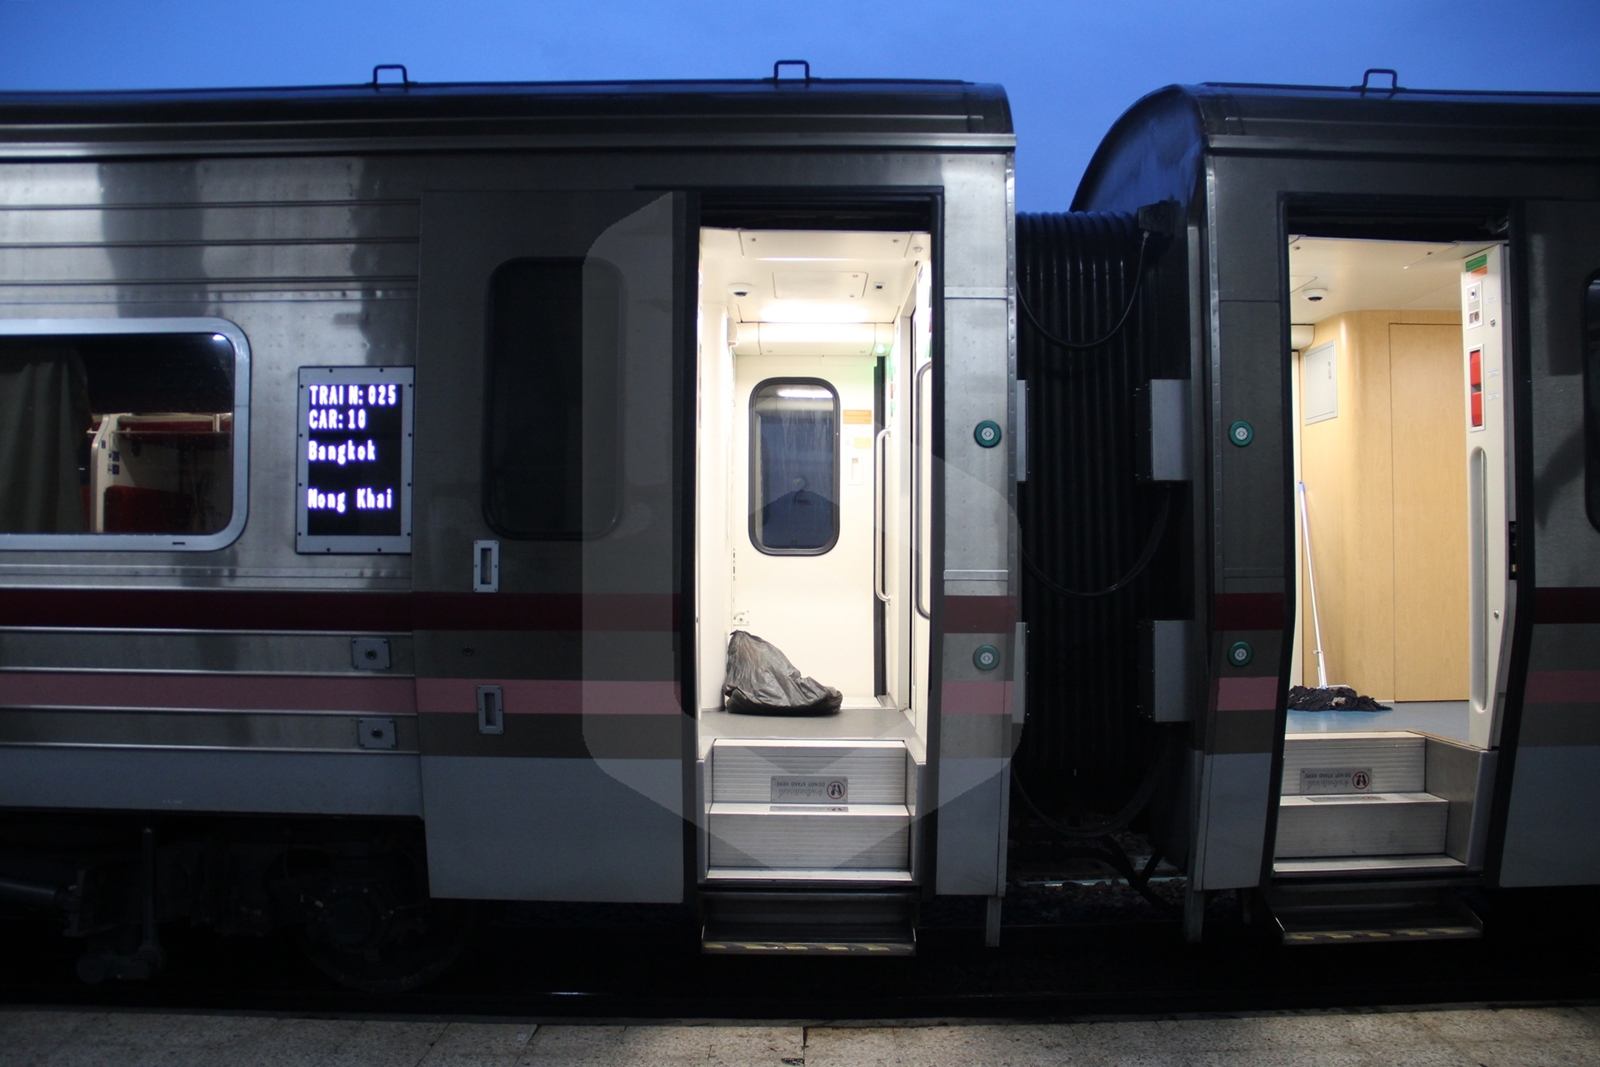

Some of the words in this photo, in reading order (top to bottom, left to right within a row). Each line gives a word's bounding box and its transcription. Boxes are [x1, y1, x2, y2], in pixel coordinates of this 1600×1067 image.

[308, 439, 376, 466] Bangkok
[307, 488, 346, 514] Nong
[356, 487, 392, 509] Khai
